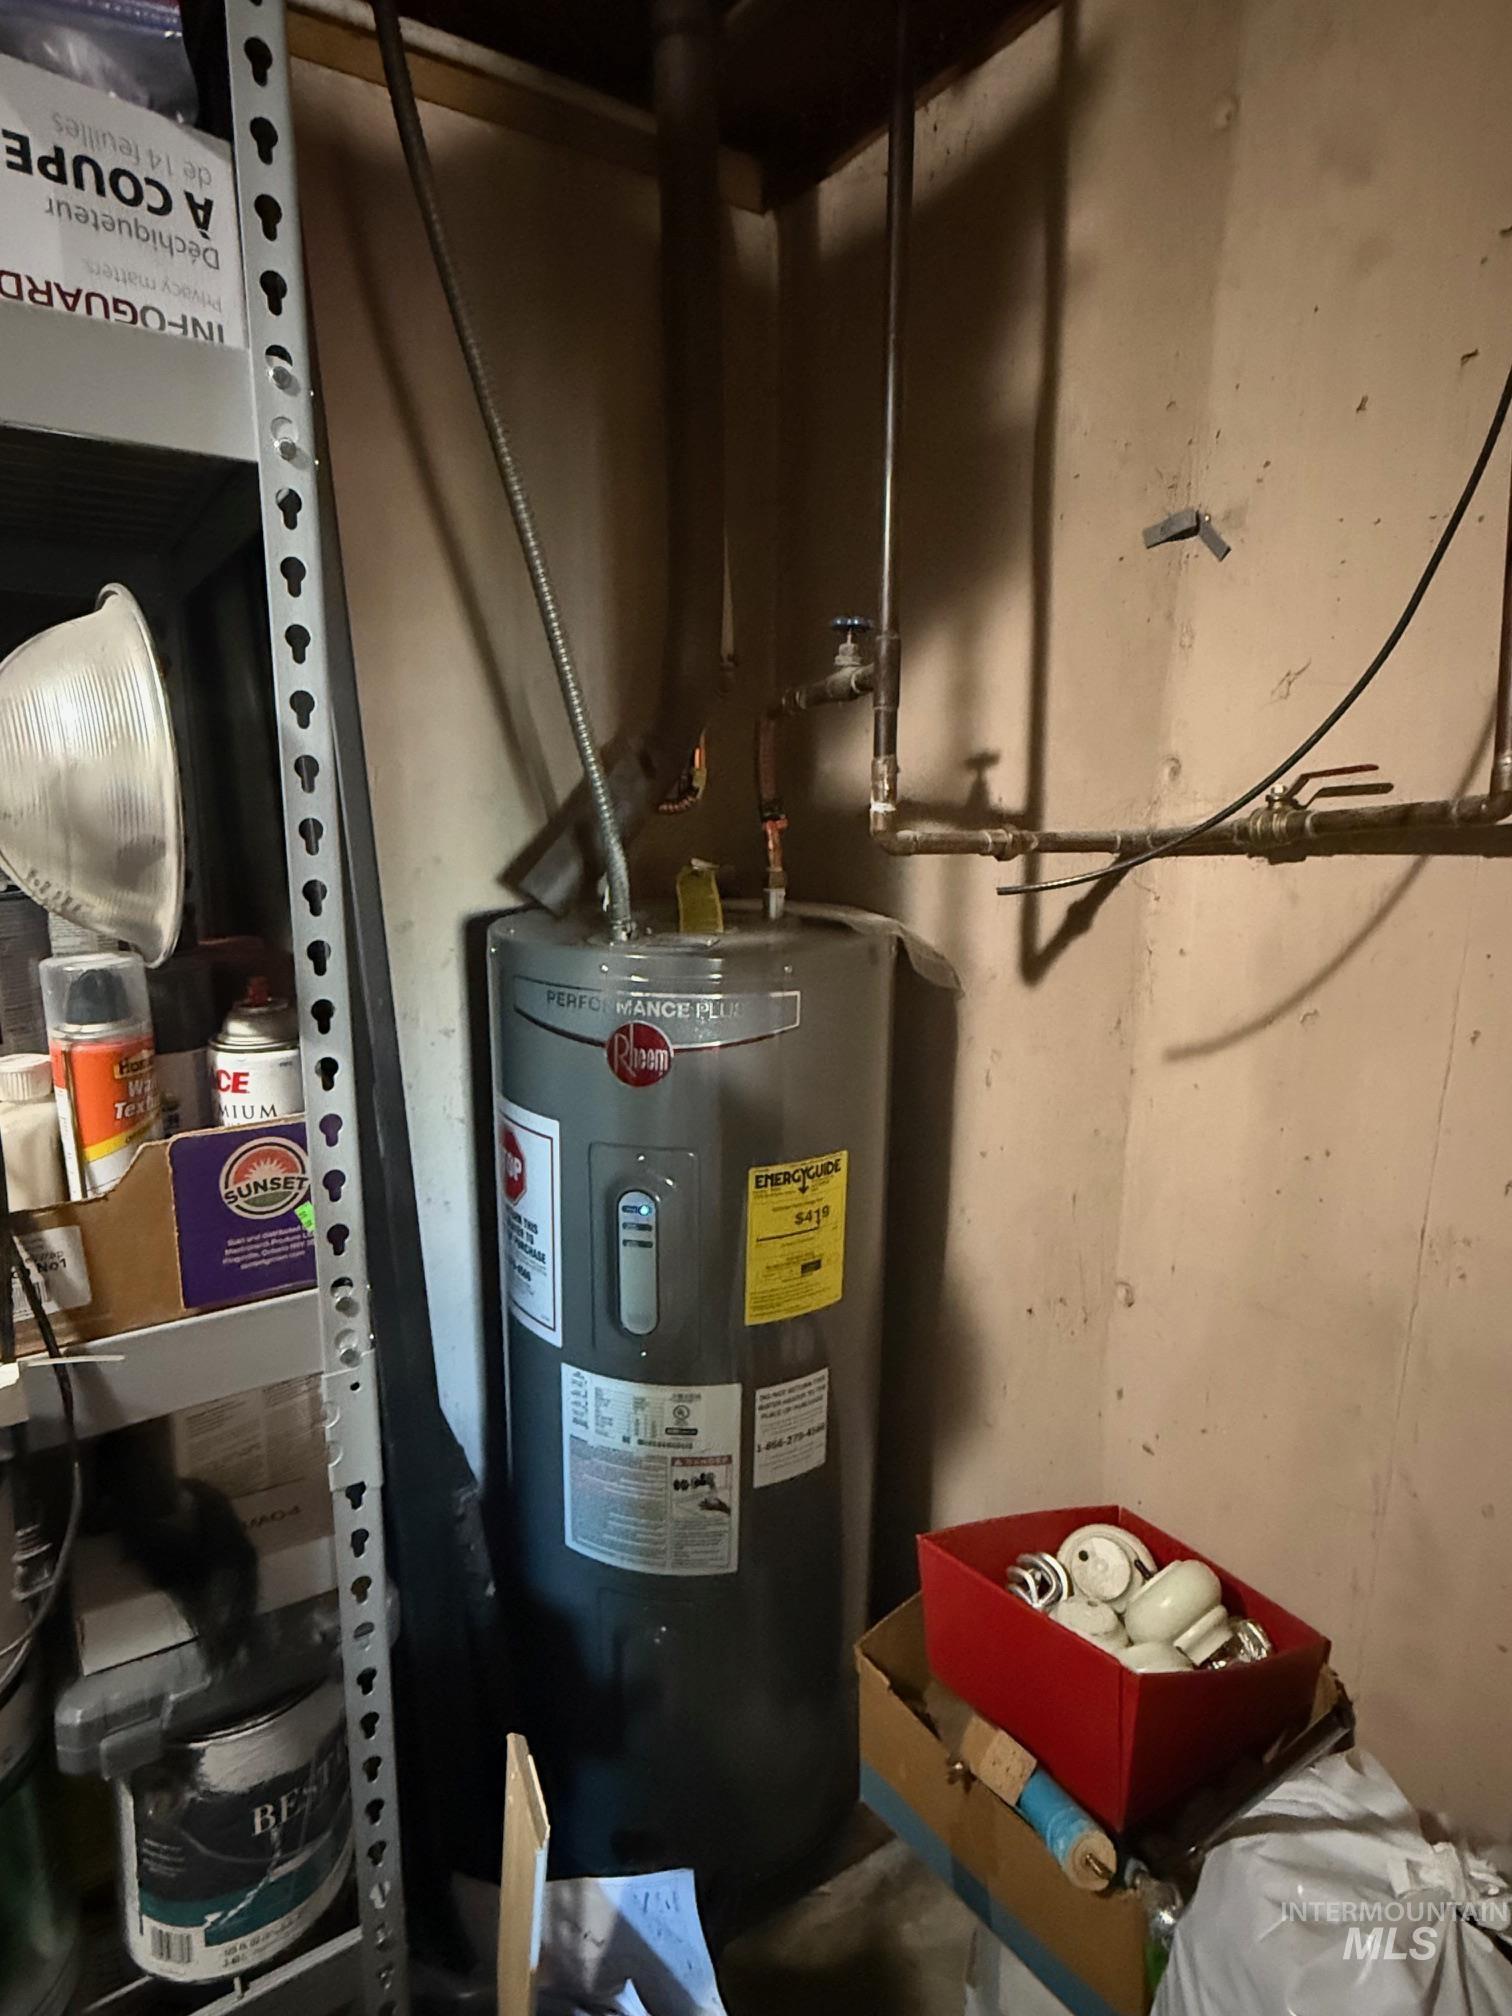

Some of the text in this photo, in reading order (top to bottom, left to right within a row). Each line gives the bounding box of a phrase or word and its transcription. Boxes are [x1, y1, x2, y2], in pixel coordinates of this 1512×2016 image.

[52, 111, 212, 187] de 14 feuilles
[1, 128, 174, 217] COUPE
[45, 197, 220, 271] Déchiqueteur
[0, 269, 225, 344] INFOGUARD
[161, 276, 223, 313] Privacy
[546, 989, 690, 1019] PERFOMANCE
[613, 1022, 669, 1078] Rheem
[215, 1068, 250, 1094] CE
[224, 1175, 309, 1205] SUNSET
[754, 1159, 842, 1190] ENERGYGUIDE
